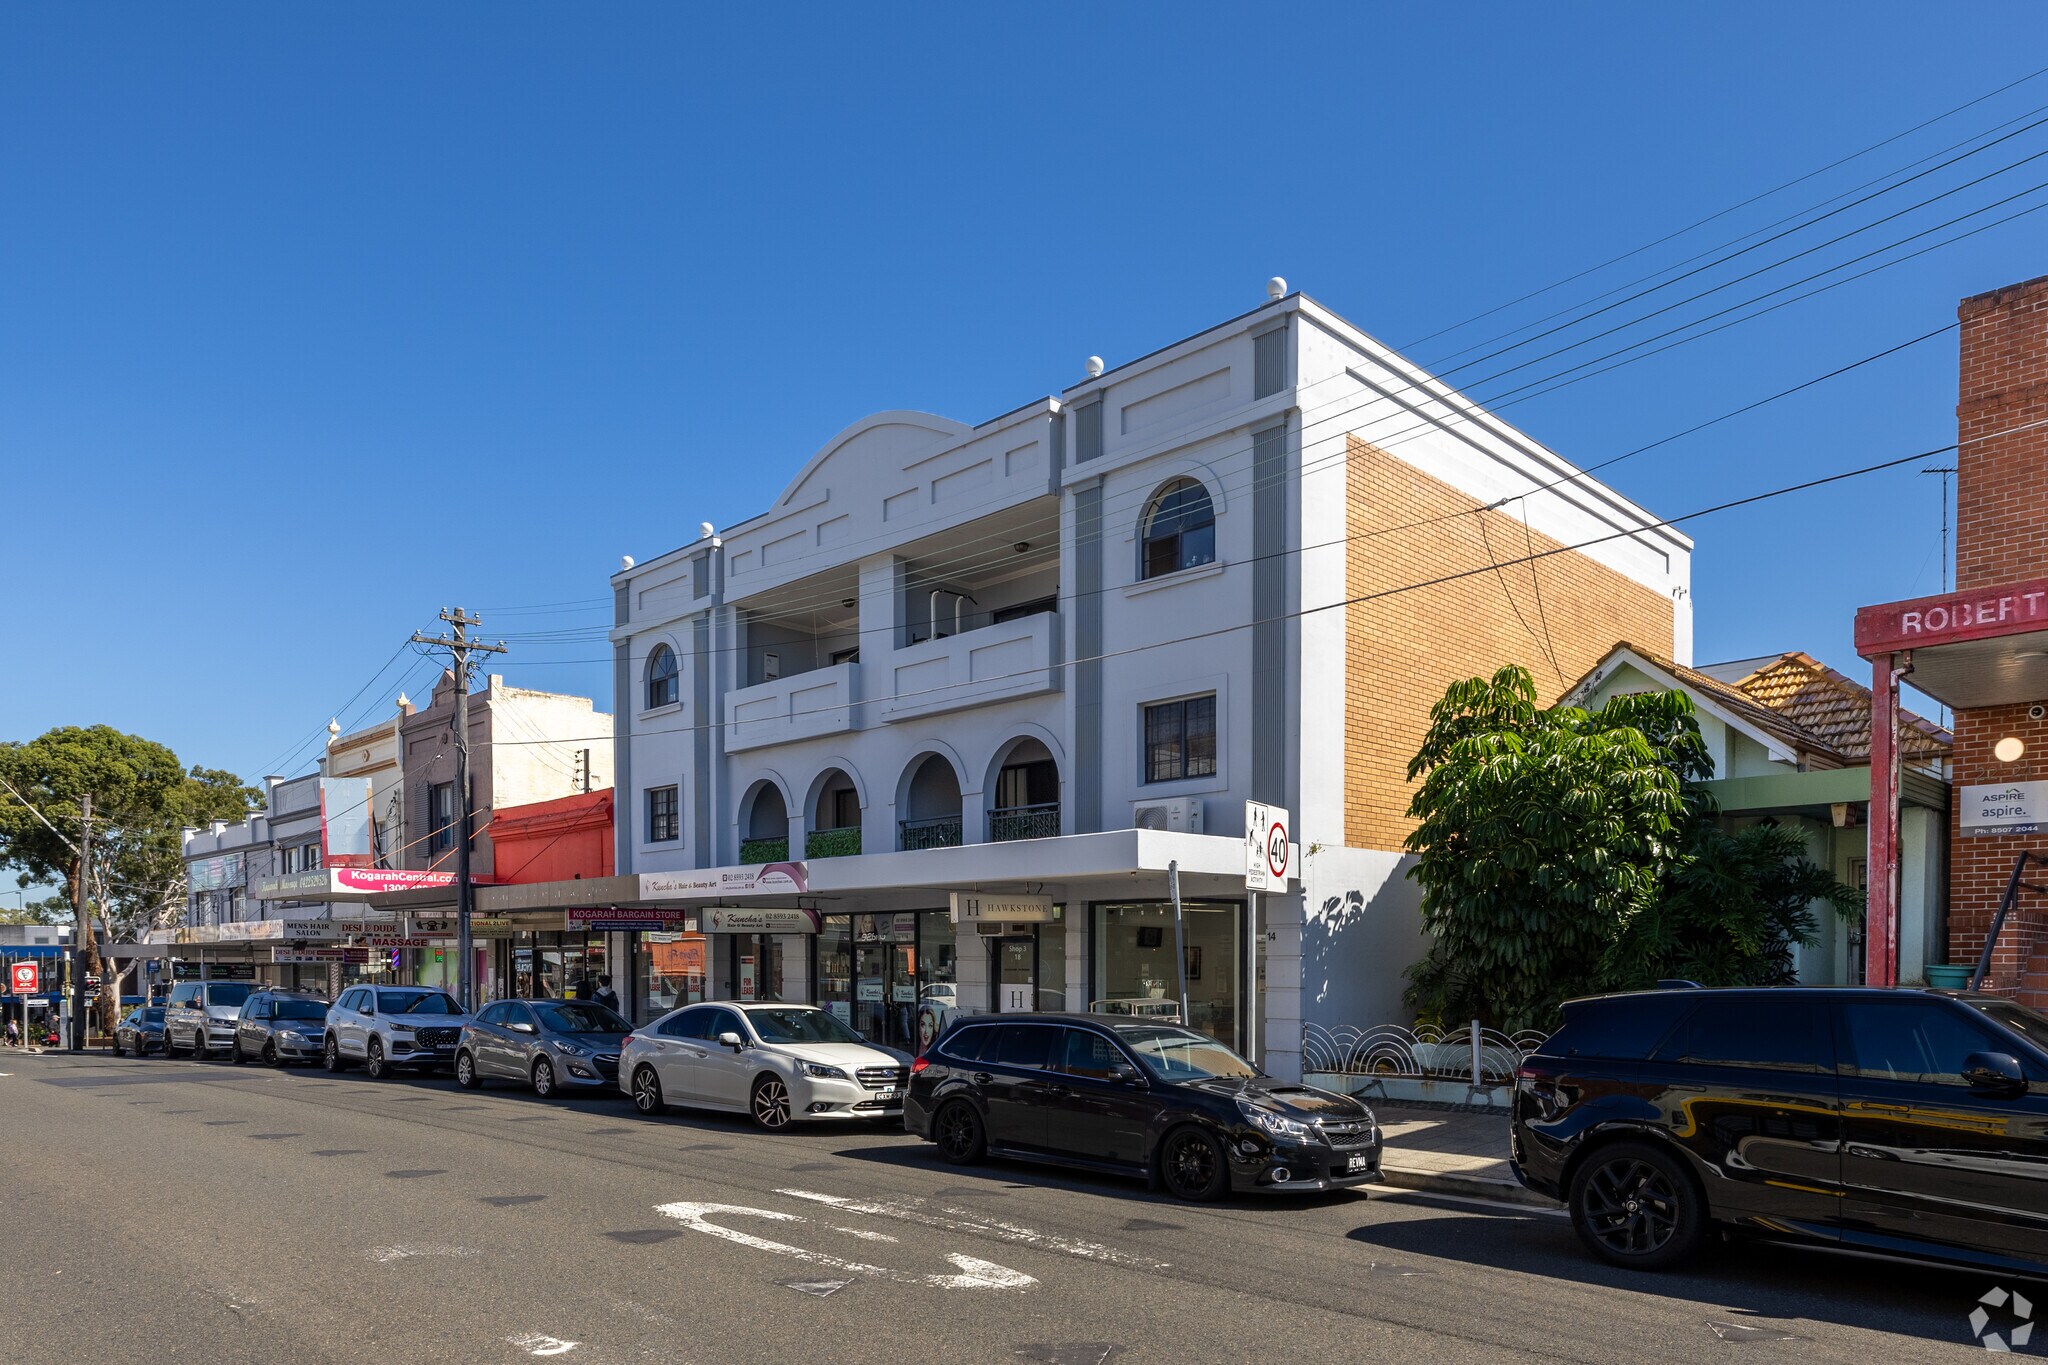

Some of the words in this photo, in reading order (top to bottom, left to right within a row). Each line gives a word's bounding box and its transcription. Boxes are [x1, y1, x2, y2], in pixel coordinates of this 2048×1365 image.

[1982, 793, 2025, 802] ASPIRE
[1982, 805, 2026, 819] aspire.
[1271, 838, 1285, 863] 40
[967, 900, 979, 916] H
[987, 904, 1048, 913] HAWKSTONE
[573, 910, 615, 918] KOGARAH
[727, 913, 763, 923] Kuncha's
[1267, 932, 1276, 941] 14
[372, 939, 428, 947] MASSAGE
[688, 984, 700, 992] LEASE
[741, 987, 753, 995] LEASE
[1011, 991, 1023, 1008] H
